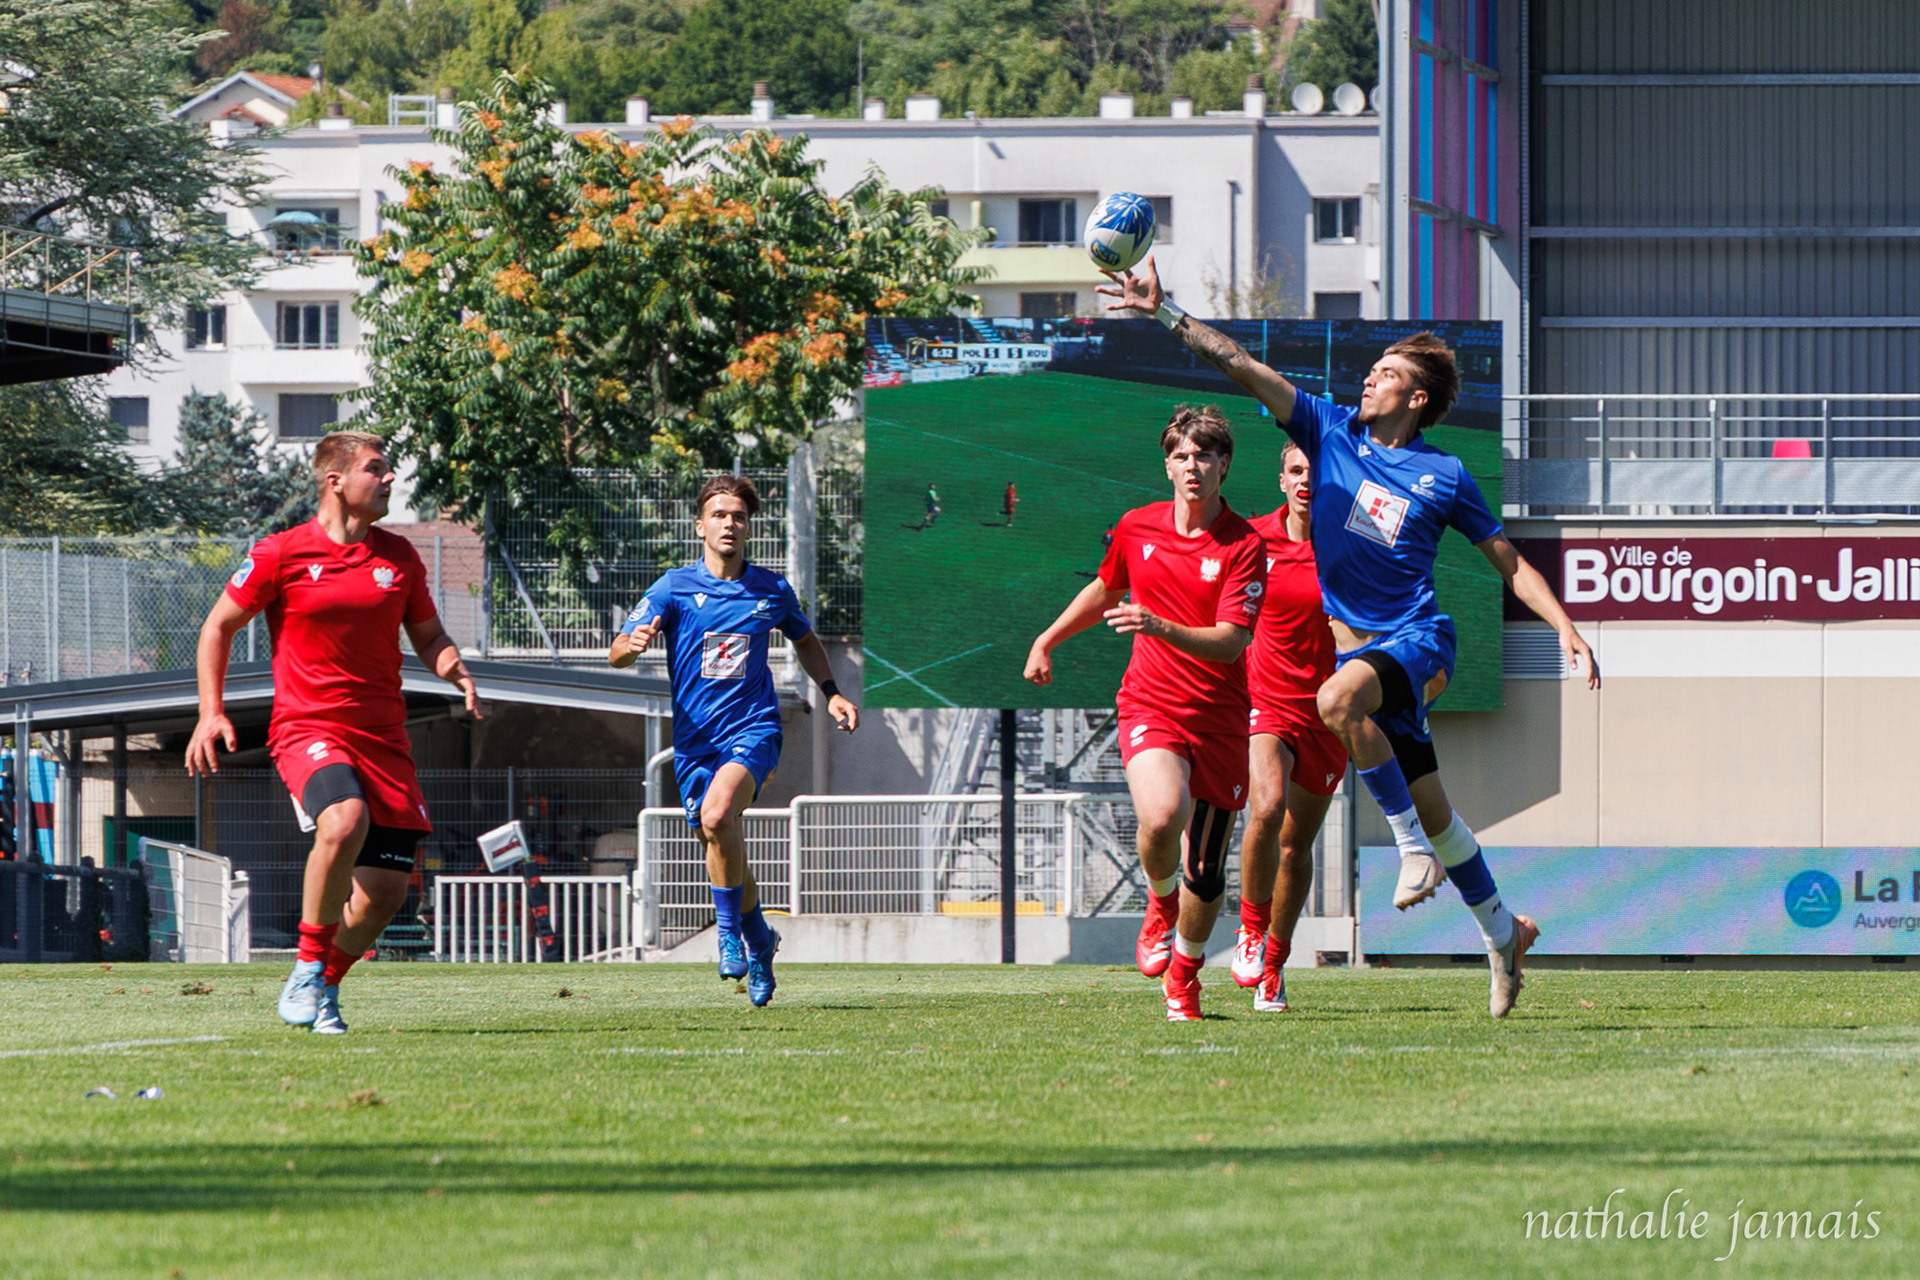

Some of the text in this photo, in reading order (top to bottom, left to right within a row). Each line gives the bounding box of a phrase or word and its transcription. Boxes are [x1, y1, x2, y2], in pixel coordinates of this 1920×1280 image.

[1609, 546, 1692, 566] Ville de
[1855, 870, 1899, 902] La
